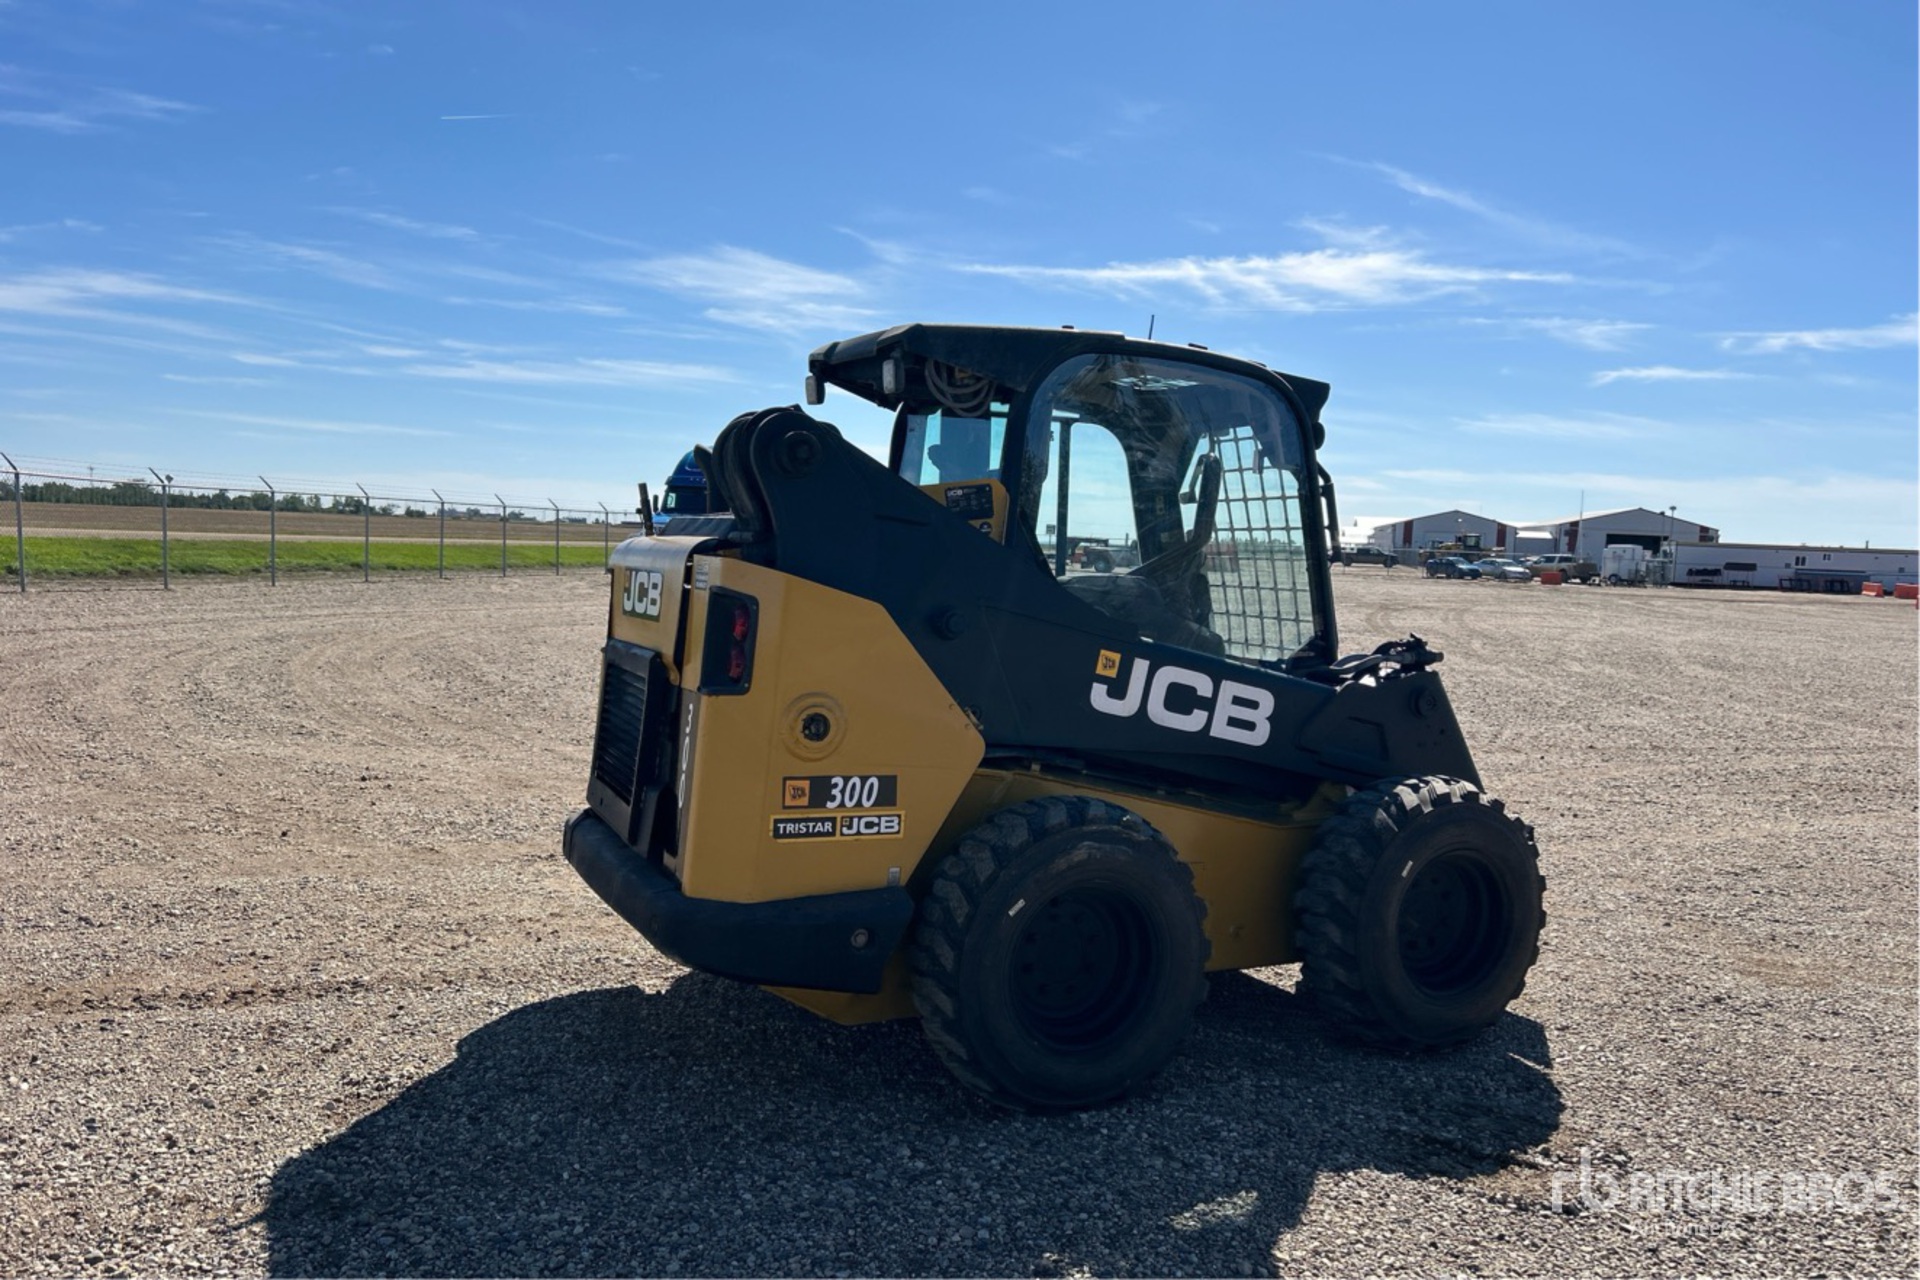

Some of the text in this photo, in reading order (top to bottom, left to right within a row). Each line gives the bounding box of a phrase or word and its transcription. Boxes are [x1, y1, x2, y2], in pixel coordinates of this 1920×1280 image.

[623, 571, 663, 616] JCB
[1090, 657, 1275, 747] JCB
[678, 703, 694, 809] 300
[825, 775, 879, 809] 300
[777, 816, 900, 835] TRISTAR JCB
